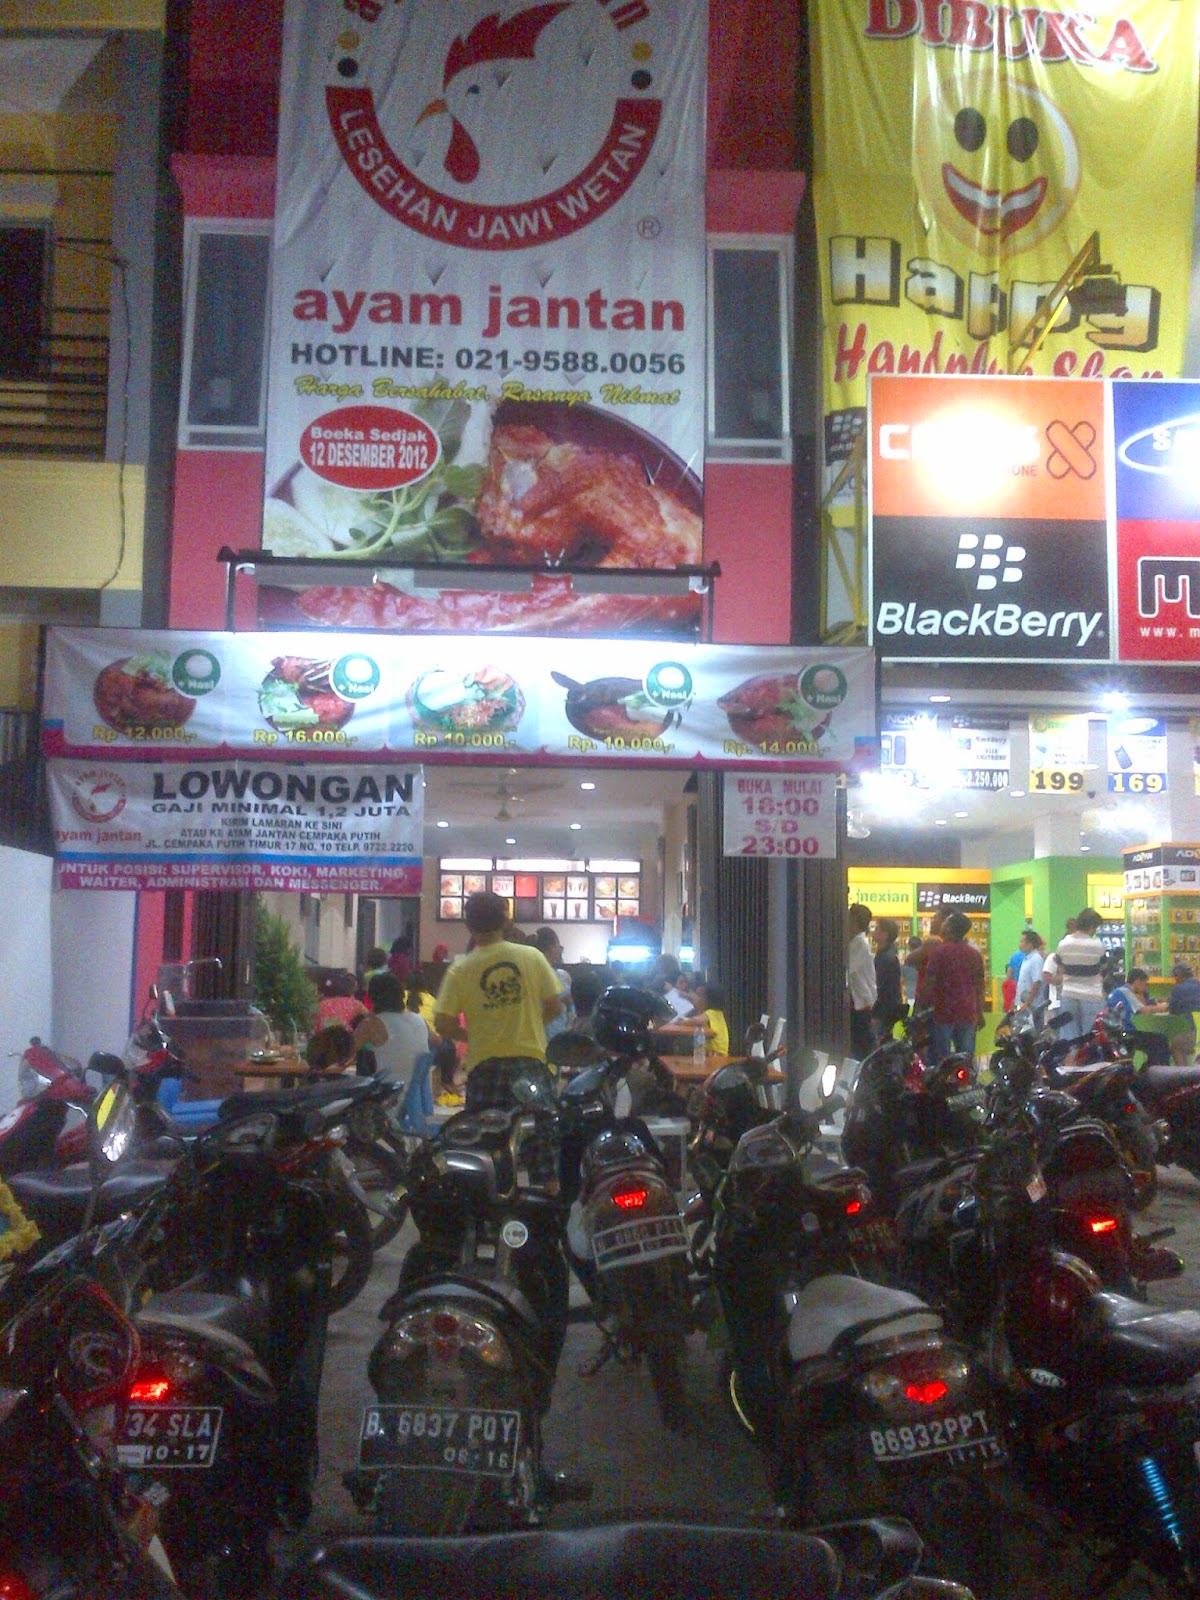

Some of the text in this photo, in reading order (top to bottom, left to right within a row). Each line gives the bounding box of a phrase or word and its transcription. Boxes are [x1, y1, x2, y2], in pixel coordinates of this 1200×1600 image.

[864, 0, 1159, 72] DIBUKA
[340, 109, 647, 240] LESEHAN JAWI WETAN
[292, 285, 685, 338] ayam jantan
[290, 343, 686, 375] HOTLINE: 021-9588.0056
[294, 374, 363, 402] Harga
[501, 381, 592, 407] Rasanya
[600, 383, 681, 405] Nikmat
[310, 426, 427, 443] Boeka Sedjak
[309, 441, 428, 470] 12 DESEMBER 2012
[876, 602, 1103, 647] BlackBerry
[93, 725, 117, 743] Rp
[254, 729, 278, 746] Rp
[414, 732, 438, 748] Rp
[568, 735, 597, 752] Rp.
[723, 739, 753, 756] Rp.
[153, 769, 413, 803] LOWONGAN
[737, 779, 821, 794] BUKA MULAI
[1035, 771, 1084, 790] 199
[1113, 773, 1163, 793] 169
[152, 802, 411, 819] GAJI MINIMAL 1,2 JUTA
[252, 818, 302, 829] LAMARAN
[305, 820, 319, 829] KE
[322, 820, 342, 830] SINI
[96, 827, 142, 844] jantan
[180, 828, 207, 838] ATAU
[255, 830, 296, 840] JANTAN
[299, 831, 347, 841] CEMPAKA
[351, 832, 380, 841] PUTIH
[164, 839, 213, 849] CEMPAKA
[250, 840, 281, 849] TIMUR
[285, 841, 296, 850] 17
[321, 842, 332, 851] 10
[742, 835, 819, 856] 23:00
[171, 864, 265, 877] SUPERVISOR,
[80, 876, 141, 888] WAITER,
[147, 877, 249, 888] ADMINISTRASI
[255, 878, 283, 888] DAN
[942, 893, 987, 905] BlackBerry
[167, 1412, 211, 1438] SLA
